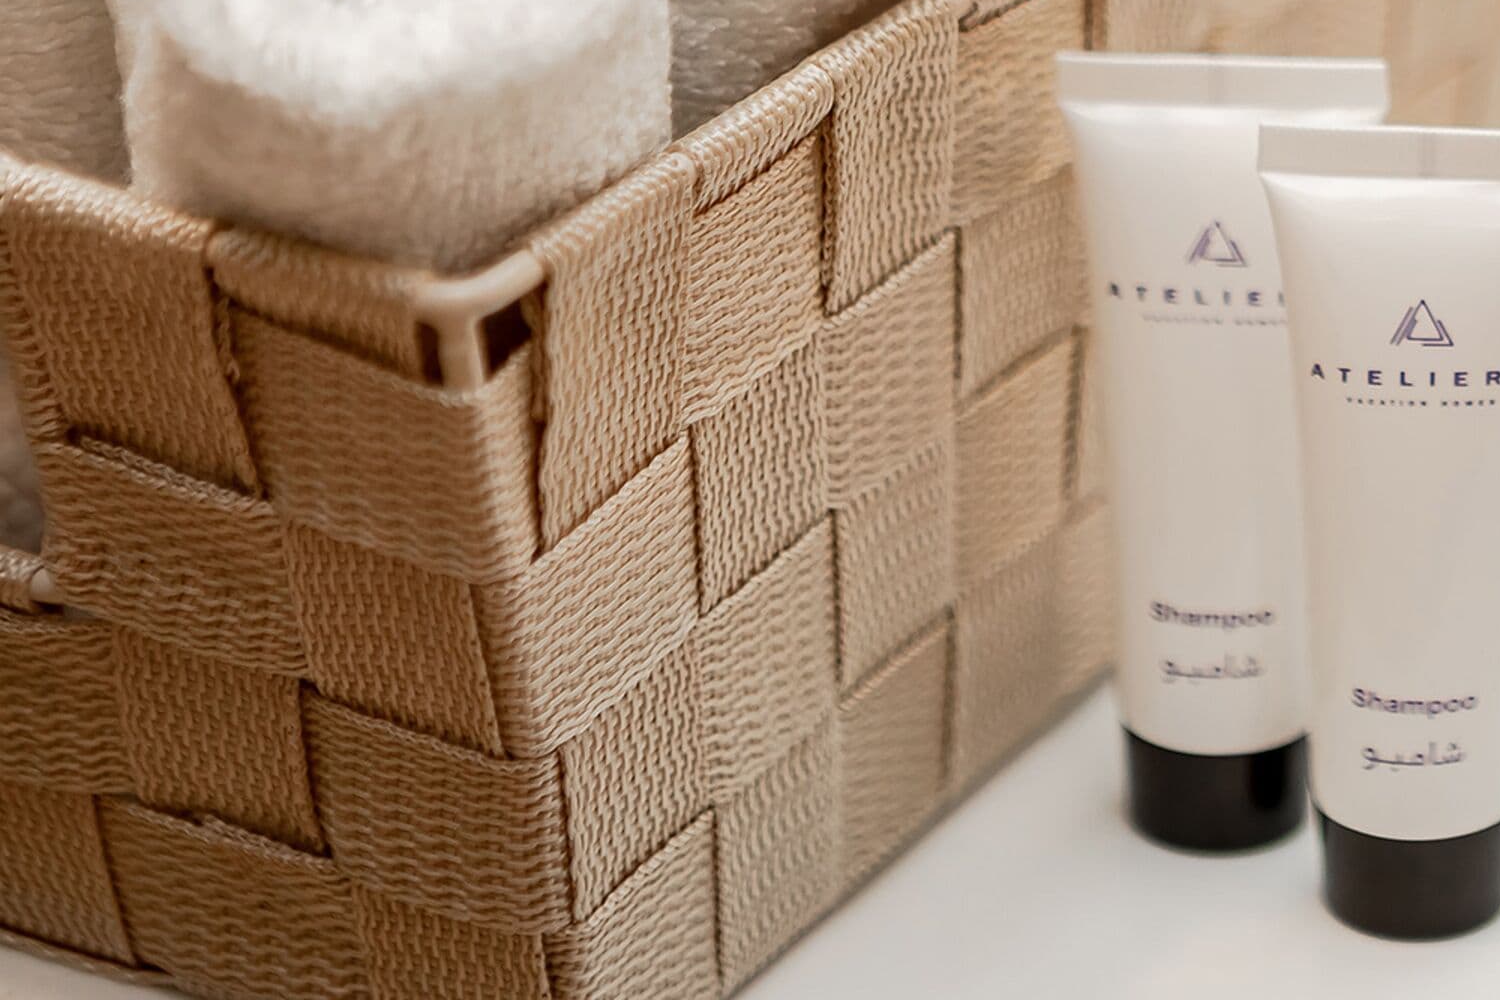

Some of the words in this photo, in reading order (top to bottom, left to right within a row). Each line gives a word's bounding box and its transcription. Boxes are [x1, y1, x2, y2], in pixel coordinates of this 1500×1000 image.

[1151, 601, 1275, 630] Shampoo
[1160, 653, 1265, 684] شامبو
[1352, 687, 1479, 719] Shampoo
[1362, 742, 1465, 772] شامبو
